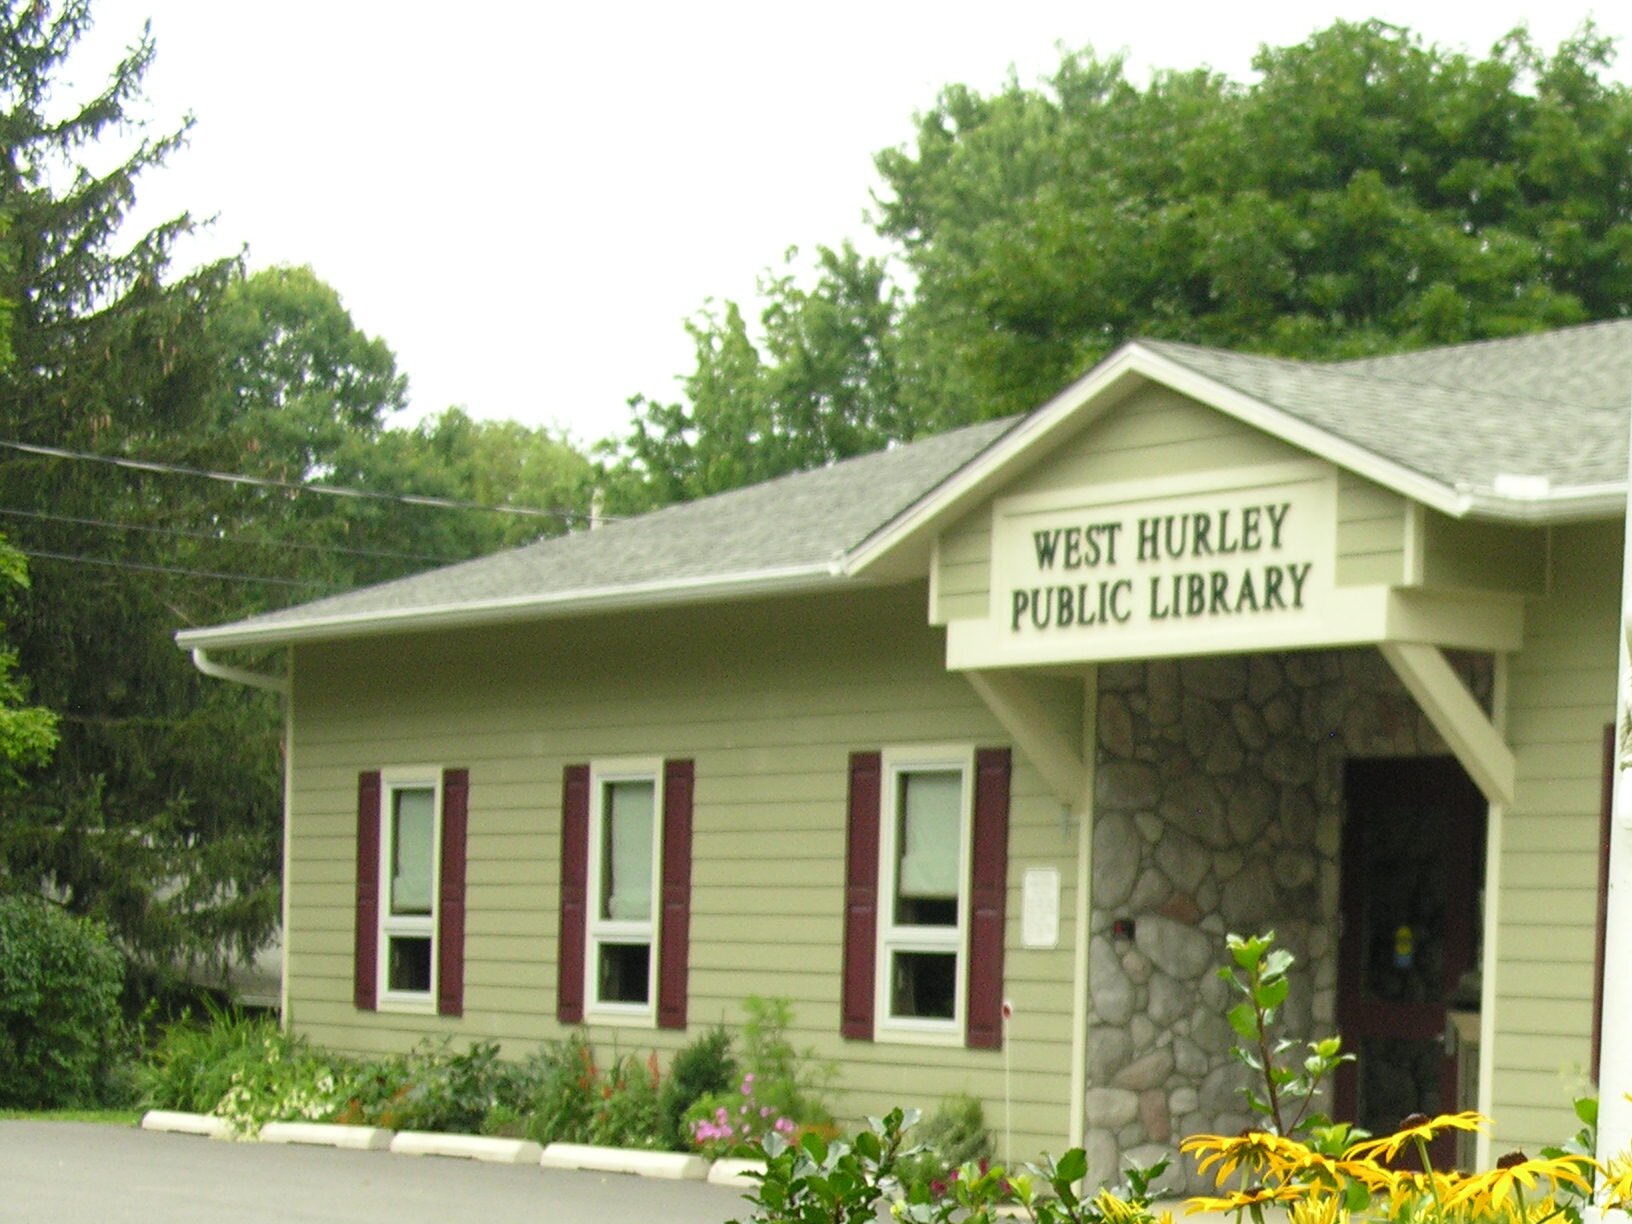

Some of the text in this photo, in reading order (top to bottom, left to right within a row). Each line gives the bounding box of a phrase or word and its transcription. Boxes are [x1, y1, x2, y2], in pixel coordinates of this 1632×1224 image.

[1033, 503, 1291, 570] WEST HURLEY
[1011, 563, 1312, 631] PUBLIC LIBRARY
